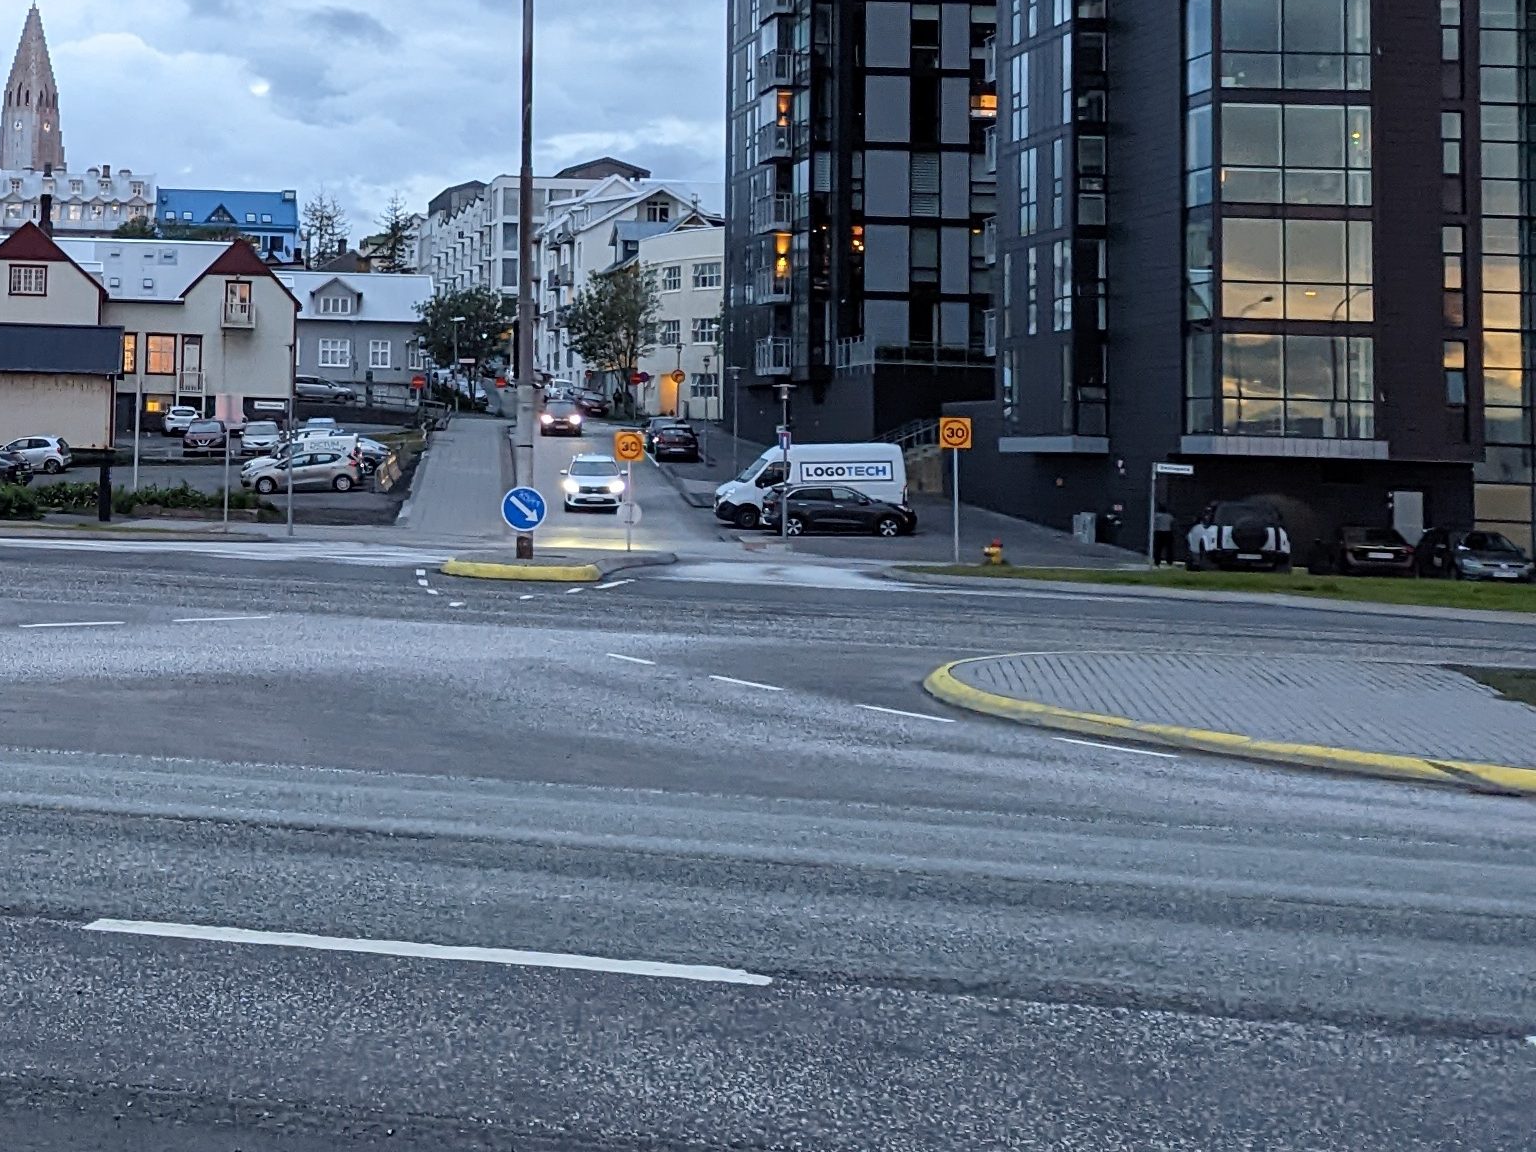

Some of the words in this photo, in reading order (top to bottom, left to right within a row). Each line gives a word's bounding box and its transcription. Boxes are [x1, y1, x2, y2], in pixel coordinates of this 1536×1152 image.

[946, 427, 965, 438] 30
[621, 441, 637, 451] 30
[805, 465, 887, 477] LOGOTECH
